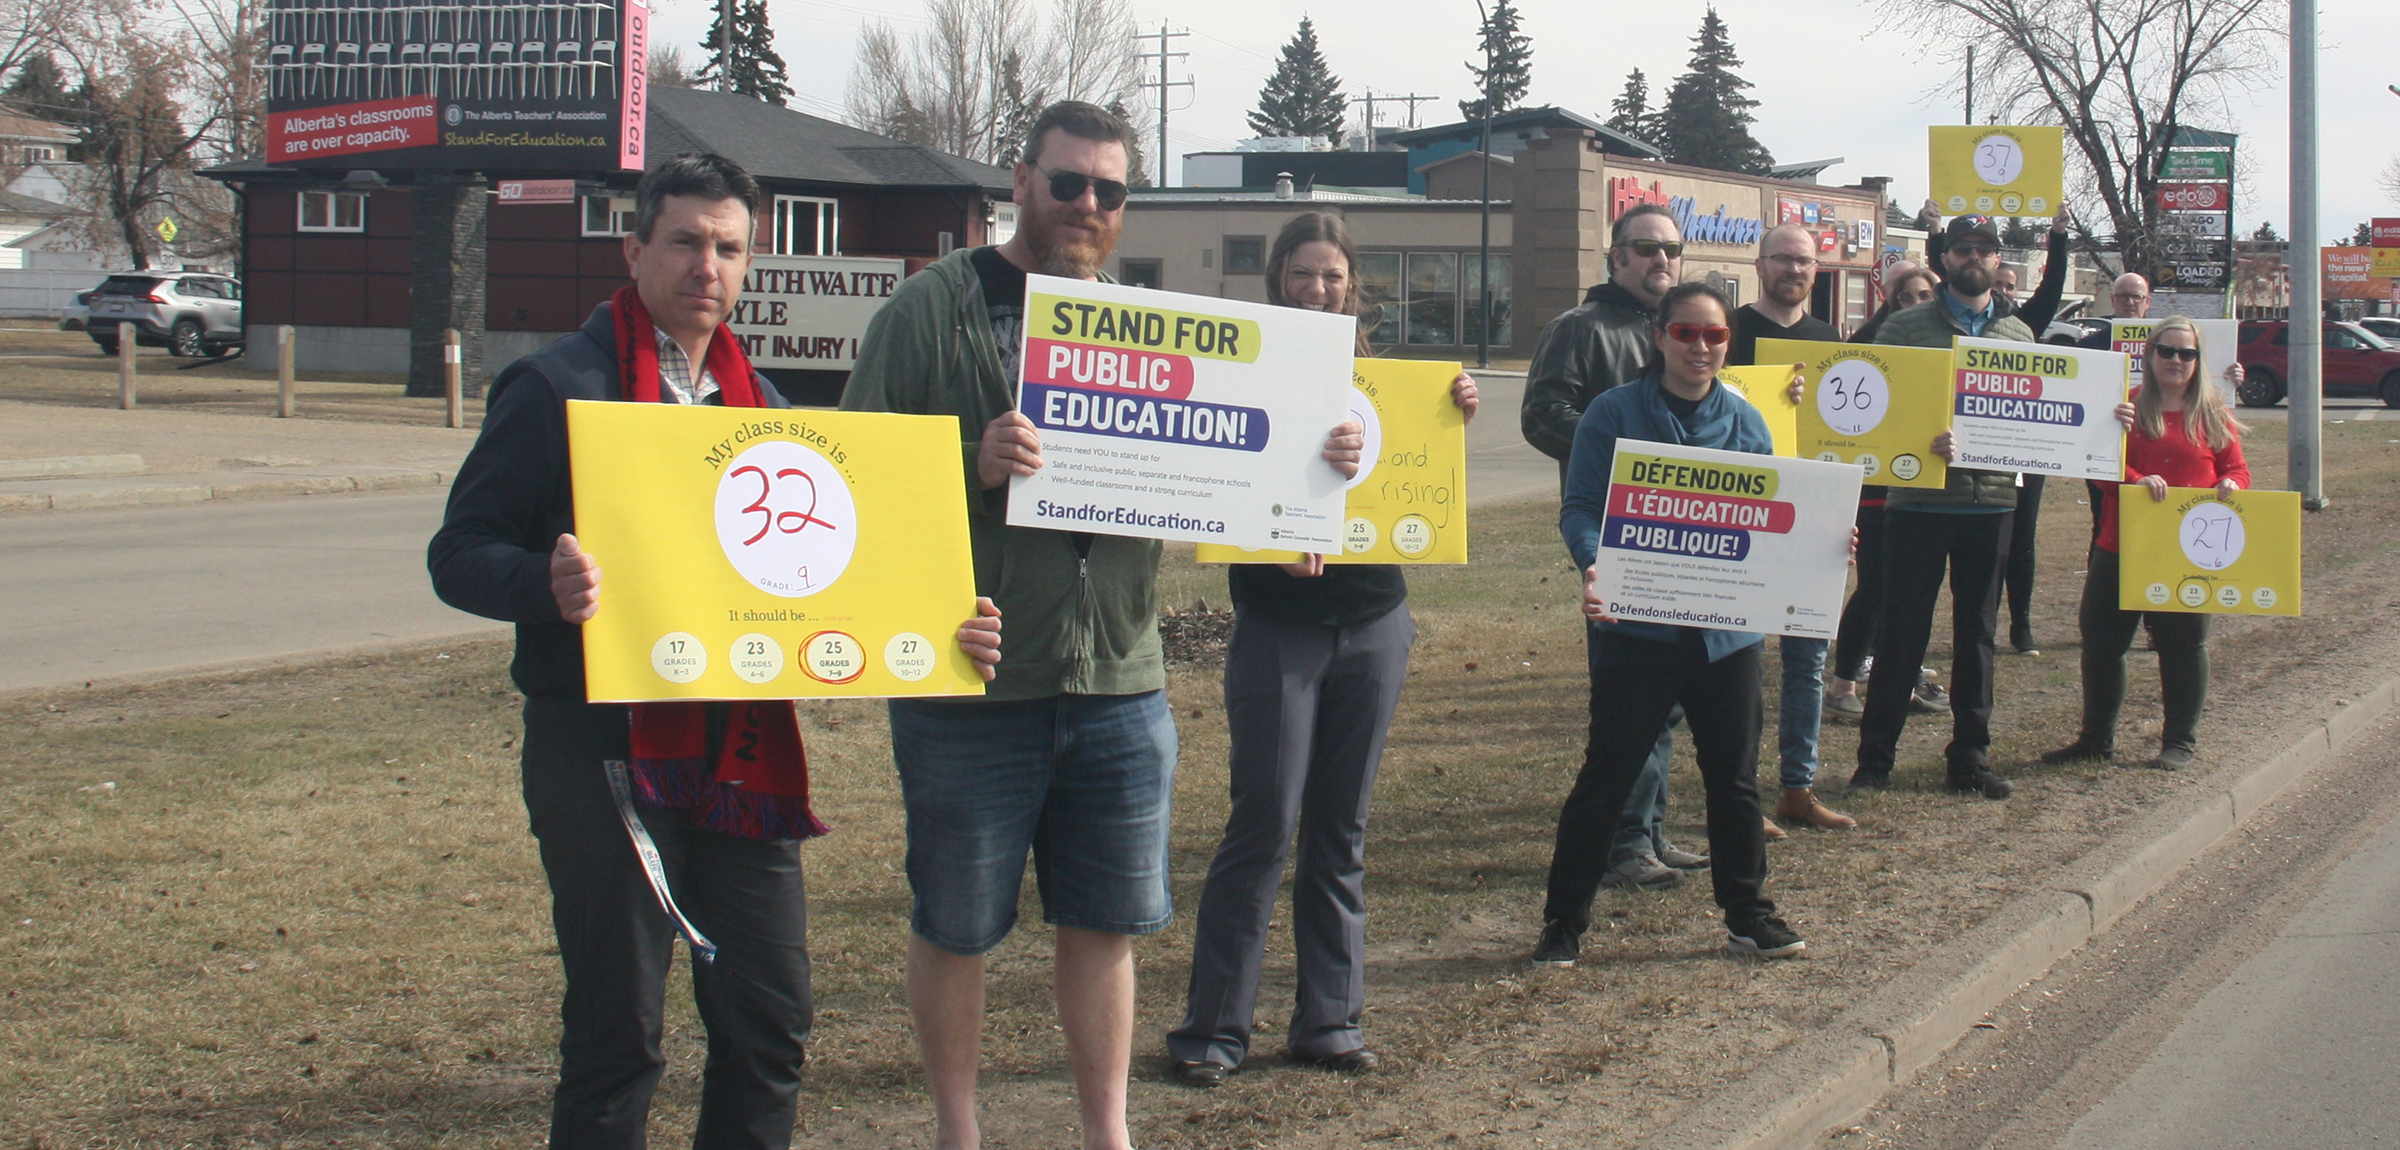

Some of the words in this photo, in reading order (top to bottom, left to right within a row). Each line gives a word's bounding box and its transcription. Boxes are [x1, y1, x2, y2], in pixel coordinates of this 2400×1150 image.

[629, 16, 645, 156] outdoor.ca
[284, 113, 346, 133] Alberta's
[350, 105, 434, 126] classrooms
[464, 111, 480, 120] The
[481, 111, 512, 120] Alberta
[514, 111, 554, 120] Teachers'
[556, 111, 607, 120] Association
[285, 140, 308, 153] are
[312, 135, 343, 150] over
[347, 126, 410, 147] capacity.
[444, 131, 607, 146] StandForEducation.ca
[1980, 144, 2011, 168] 37
[742, 268, 898, 297] AITHWAITE
[2176, 267, 2223, 276] LOADED
[725, 300, 788, 326] YLE
[1052, 301, 1165, 346] STAND
[1174, 316, 1239, 356] FOR
[772, 335, 845, 360] INJURY
[1047, 345, 1172, 392] PUBLIC
[1816, 358, 1833, 373] My
[1832, 349, 1859, 361] class
[1860, 351, 1881, 365] size
[1880, 362, 1889, 372] is
[1966, 349, 2026, 371] STAND
[2032, 356, 2067, 376] FOR
[1352, 371, 1365, 385] ze
[1365, 382, 1377, 397] is
[1830, 376, 1872, 410] 36
[1964, 372, 2030, 395] PUBLIC
[1044, 390, 1248, 446] EDUCATION!
[1963, 396, 2072, 423] EDUCATION!
[703, 438, 734, 470] My
[734, 421, 784, 444] class
[789, 422, 828, 448] size
[829, 443, 847, 464] is
[1042, 443, 1072, 453] Students
[1093, 448, 1109, 456] YOU
[1120, 452, 1138, 460] stand
[1151, 454, 1160, 462] for
[1052, 461, 1068, 469] Safe
[1084, 463, 1113, 473] inclusive
[1138, 471, 1167, 480] separate
[1183, 474, 1225, 485] francophone
[1961, 453, 2062, 470] StandforEducation.ca
[1051, 475, 1094, 486] Well-funded
[1096, 480, 1132, 490] classrooms
[1134, 484, 1147, 492] and
[1154, 487, 1175, 496] strong
[1177, 489, 1212, 498] curriculum
[1631, 458, 1766, 495] DÉFENDONS
[730, 465, 836, 547] 32
[1381, 467, 1456, 529] rising!
[1625, 489, 1770, 527] L'ÉDUCATION
[1036, 500, 1225, 533] StandforEducation.ca
[1352, 523, 1365, 533] 25
[1406, 525, 1418, 534] 27
[1620, 524, 1739, 556] PUBLIQUE!
[2191, 517, 2232, 551] 27
[797, 565, 810, 588] 9
[728, 610, 739, 621] It
[743, 609, 787, 621] should
[790, 610, 805, 621] be
[1610, 602, 1747, 626] Defendonsleducation.ca
[670, 641, 685, 654] 17
[747, 642, 765, 654] 23
[825, 641, 842, 654] 25
[901, 641, 917, 653] 27
